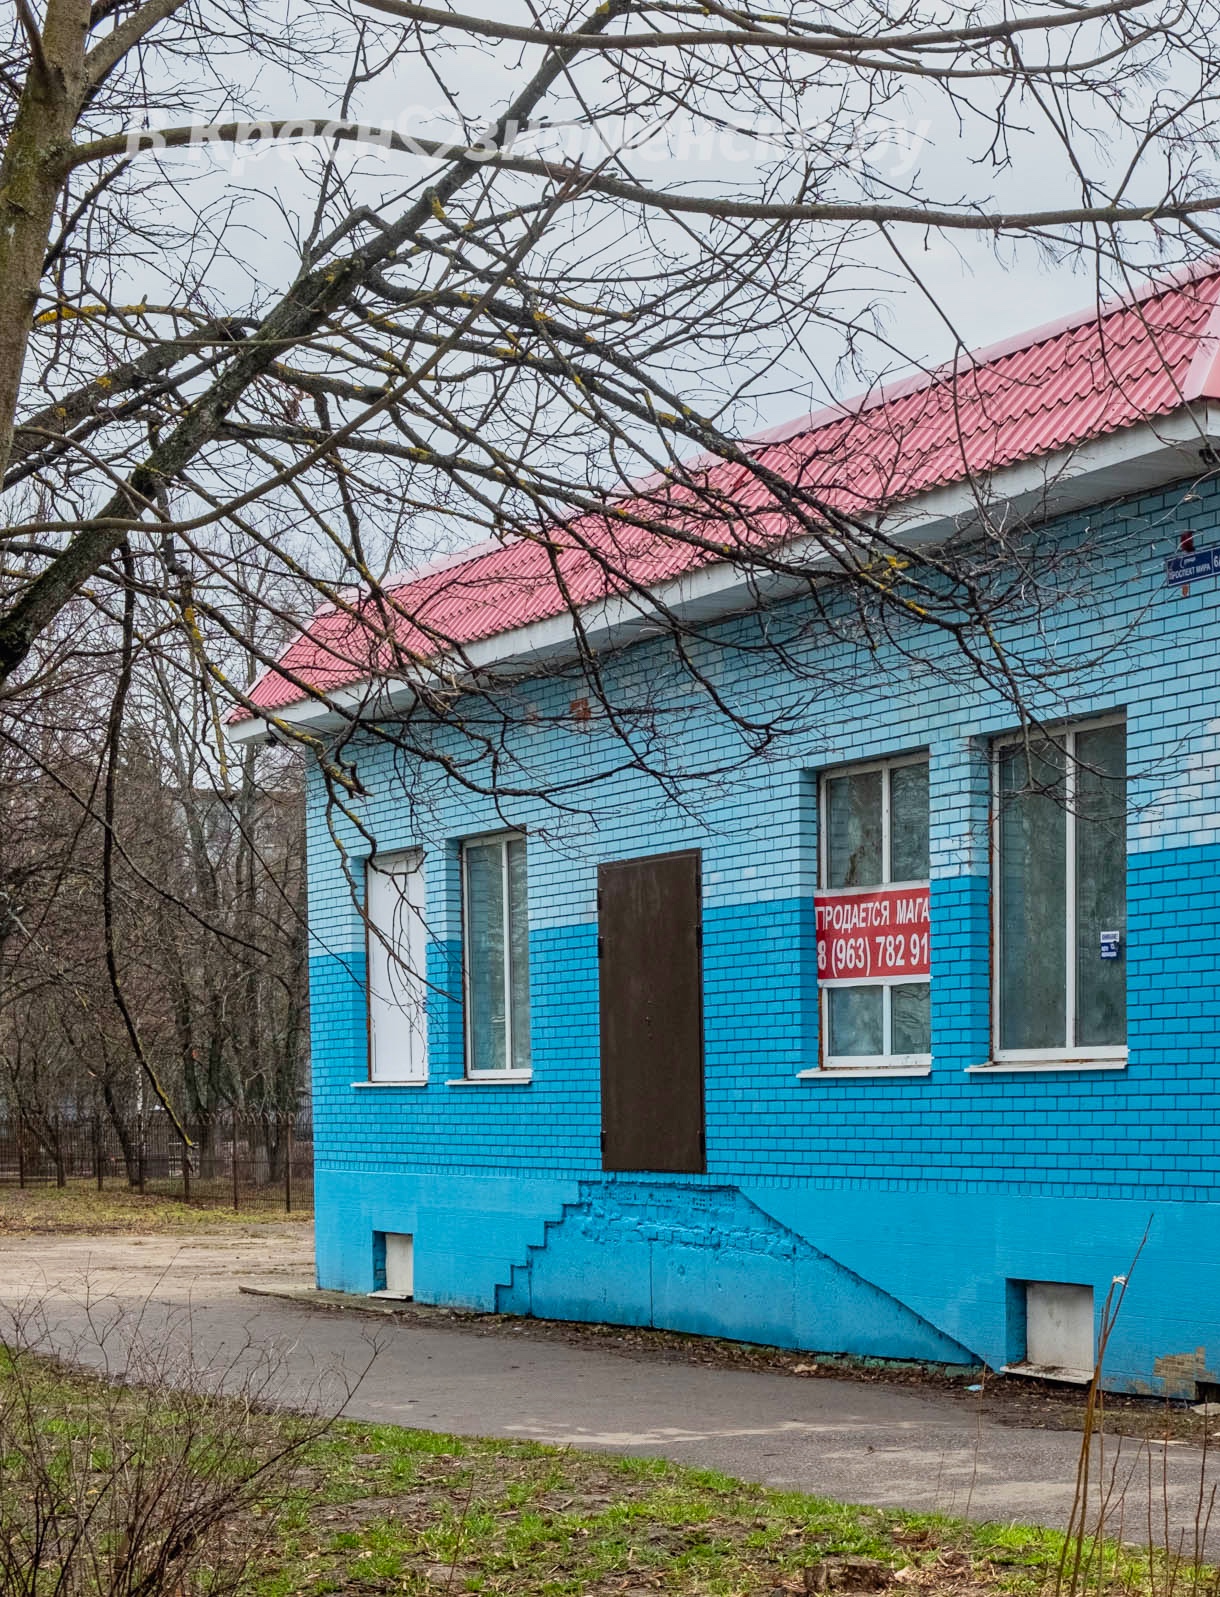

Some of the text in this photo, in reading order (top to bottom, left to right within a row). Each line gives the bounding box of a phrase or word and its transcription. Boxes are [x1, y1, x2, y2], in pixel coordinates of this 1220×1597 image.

[815, 897, 930, 934] ПРОДАЕТСЯ МАГА
[817, 932, 928, 977] 8 (963) 782 91
